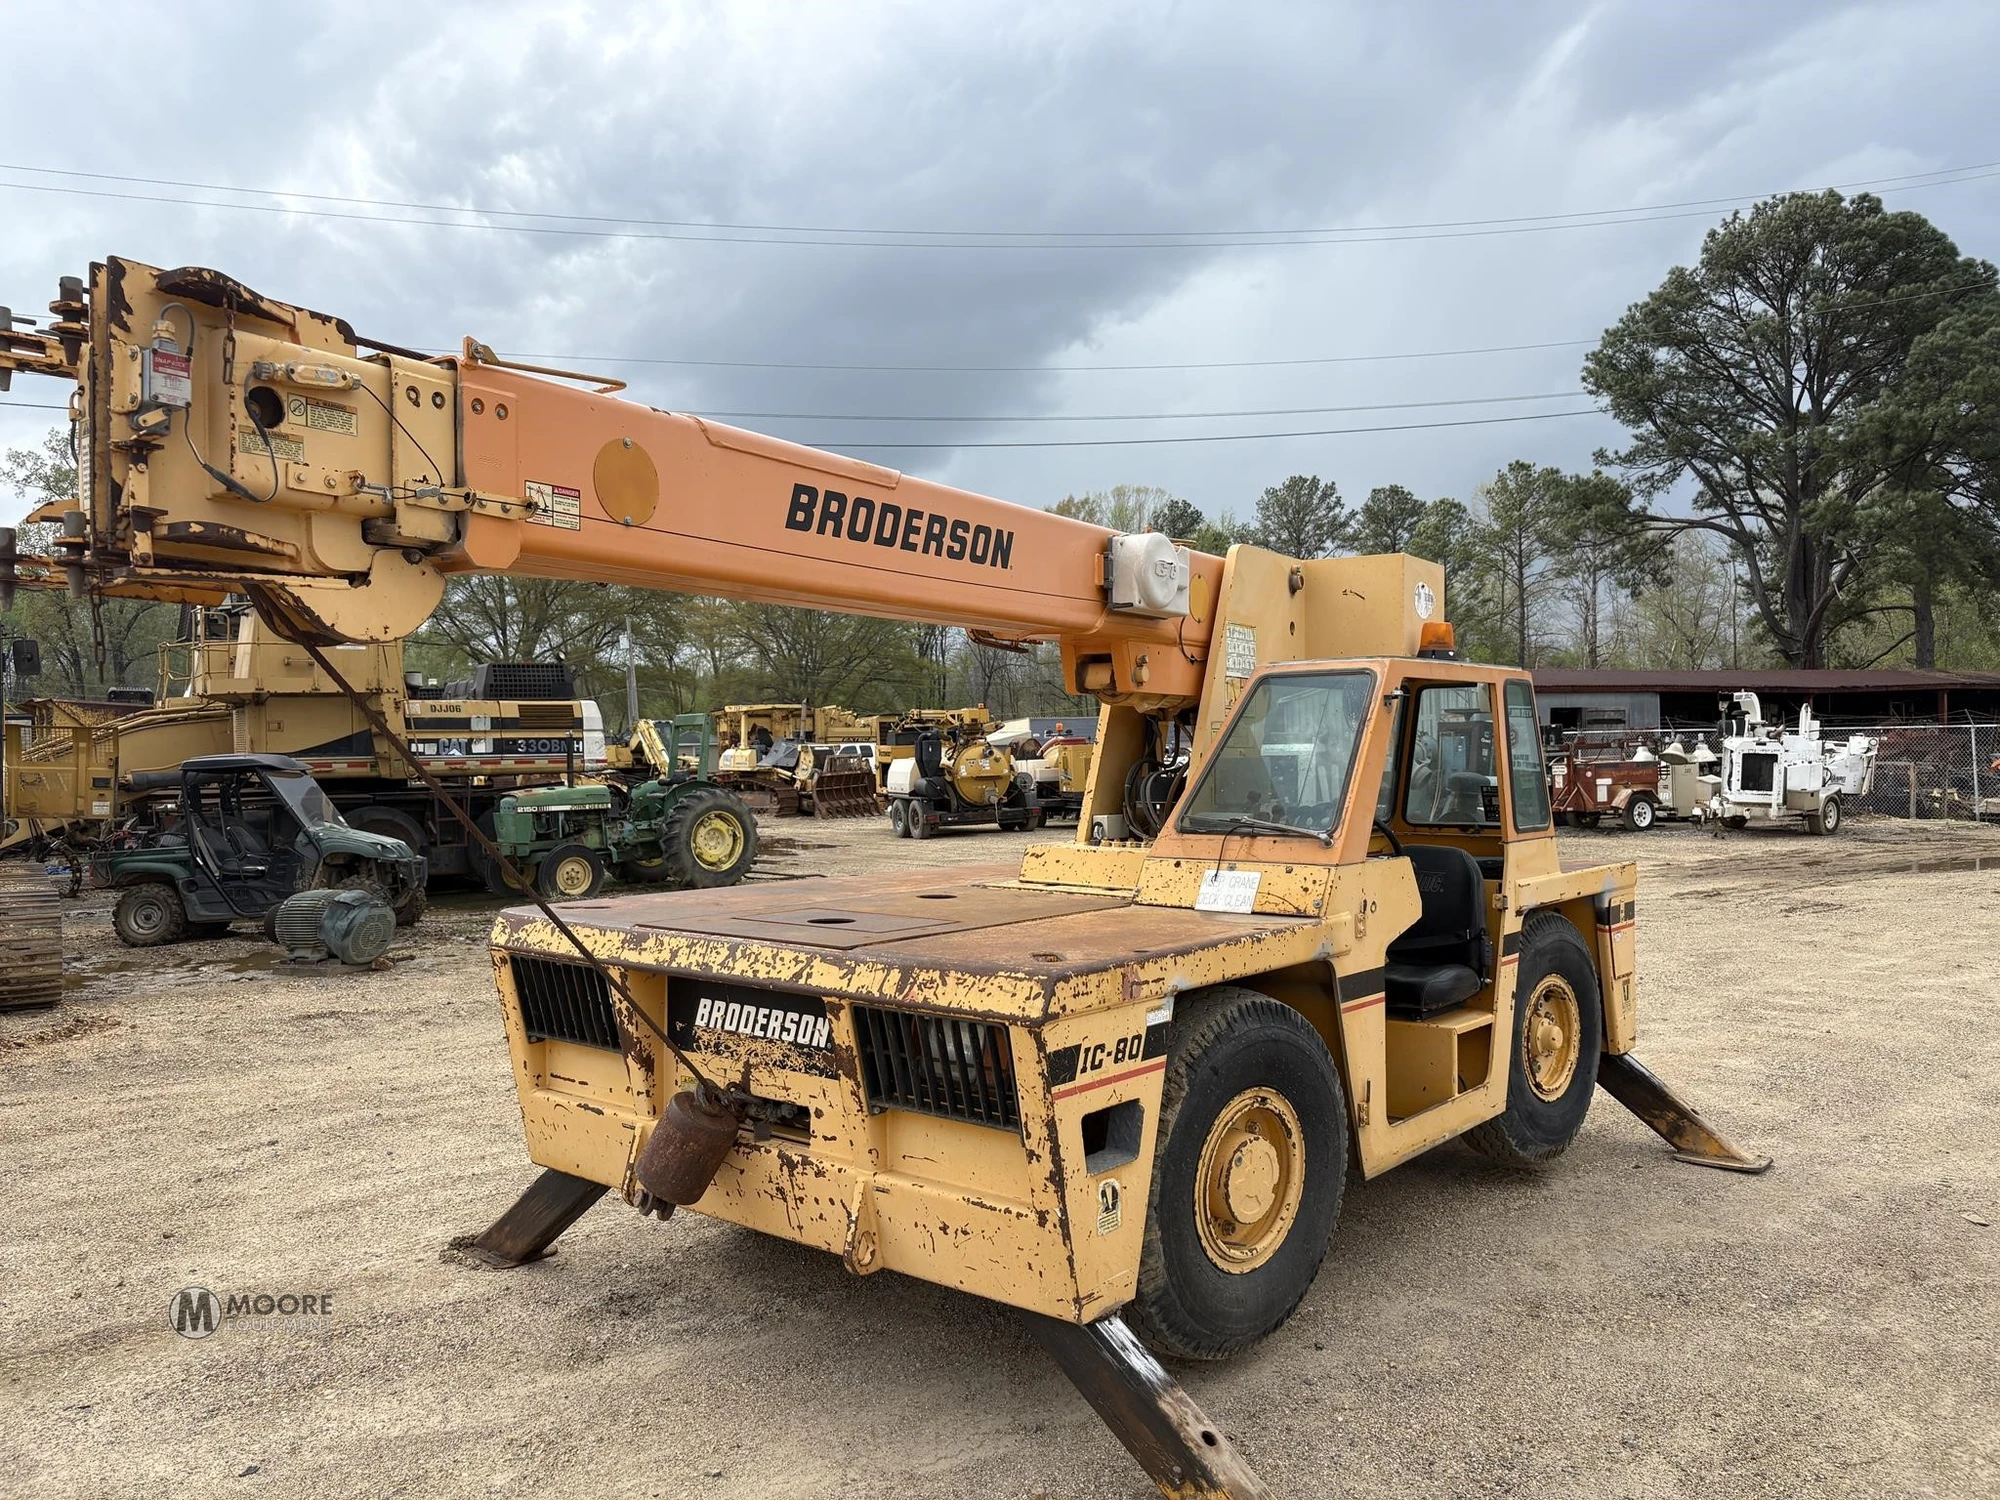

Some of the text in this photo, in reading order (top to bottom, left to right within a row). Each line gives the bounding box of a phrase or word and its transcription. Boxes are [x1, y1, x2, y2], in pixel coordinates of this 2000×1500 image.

[784, 482, 1014, 570] BRODERSON
[438, 738, 469, 756] CAT
[1228, 875, 1259, 890] CRANE
[1224, 893, 1254, 908] CLEAN
[694, 997, 831, 1049] BRODERSON
[1079, 1033, 1143, 1075] IC-80
